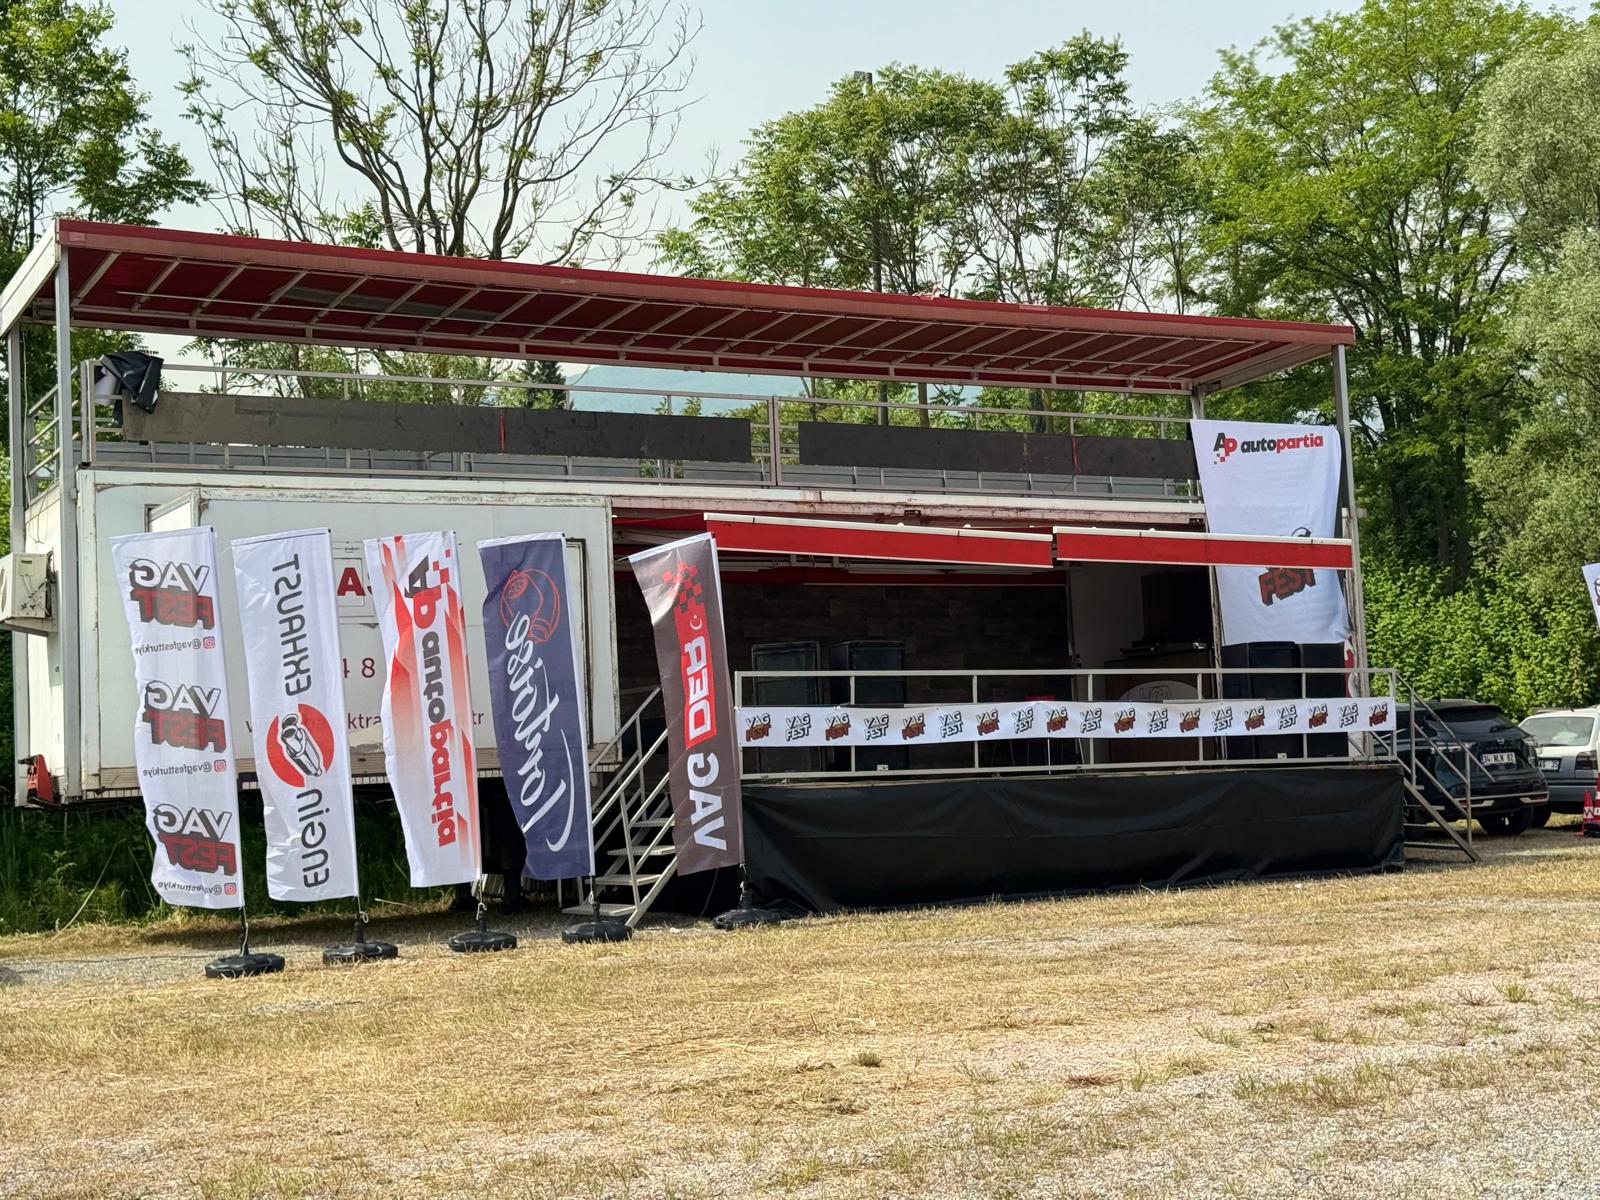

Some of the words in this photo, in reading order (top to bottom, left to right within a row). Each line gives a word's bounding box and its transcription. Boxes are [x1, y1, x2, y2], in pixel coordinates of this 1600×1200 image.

[1240, 433, 1324, 454] autopartia
[1012, 706, 1033, 721] VAG
[1046, 707, 1067, 721] VAG
[1081, 707, 1102, 721] VAG
[1114, 708, 1135, 721] VAG
[1147, 708, 1168, 722] VAG
[1180, 708, 1200, 721] VAG
[1212, 706, 1232, 720] VAG
[1245, 705, 1264, 720] VAG
[1277, 704, 1296, 718] VAG
[1309, 703, 1327, 717] VAG
[1340, 702, 1358, 717] VAG
[1370, 702, 1387, 716] VAG
[745, 713, 771, 728] VAG
[785, 713, 811, 729] VAG
[825, 713, 850, 728] VAG
[864, 714, 889, 729] VAG
[902, 713, 925, 728] VAG
[940, 711, 962, 726] VAG
[976, 709, 998, 727] VAG
[1014, 717, 1033, 734] FEST
[1212, 717, 1233, 732] FEST
[1277, 714, 1298, 729] FEST
[1340, 713, 1359, 728] FEST
[786, 724, 811, 741] FEST
[865, 723, 889, 740] FEST
[940, 721, 963, 738] FEST
[1081, 719, 1102, 733] FEST
[1147, 719, 1168, 733] FEST
